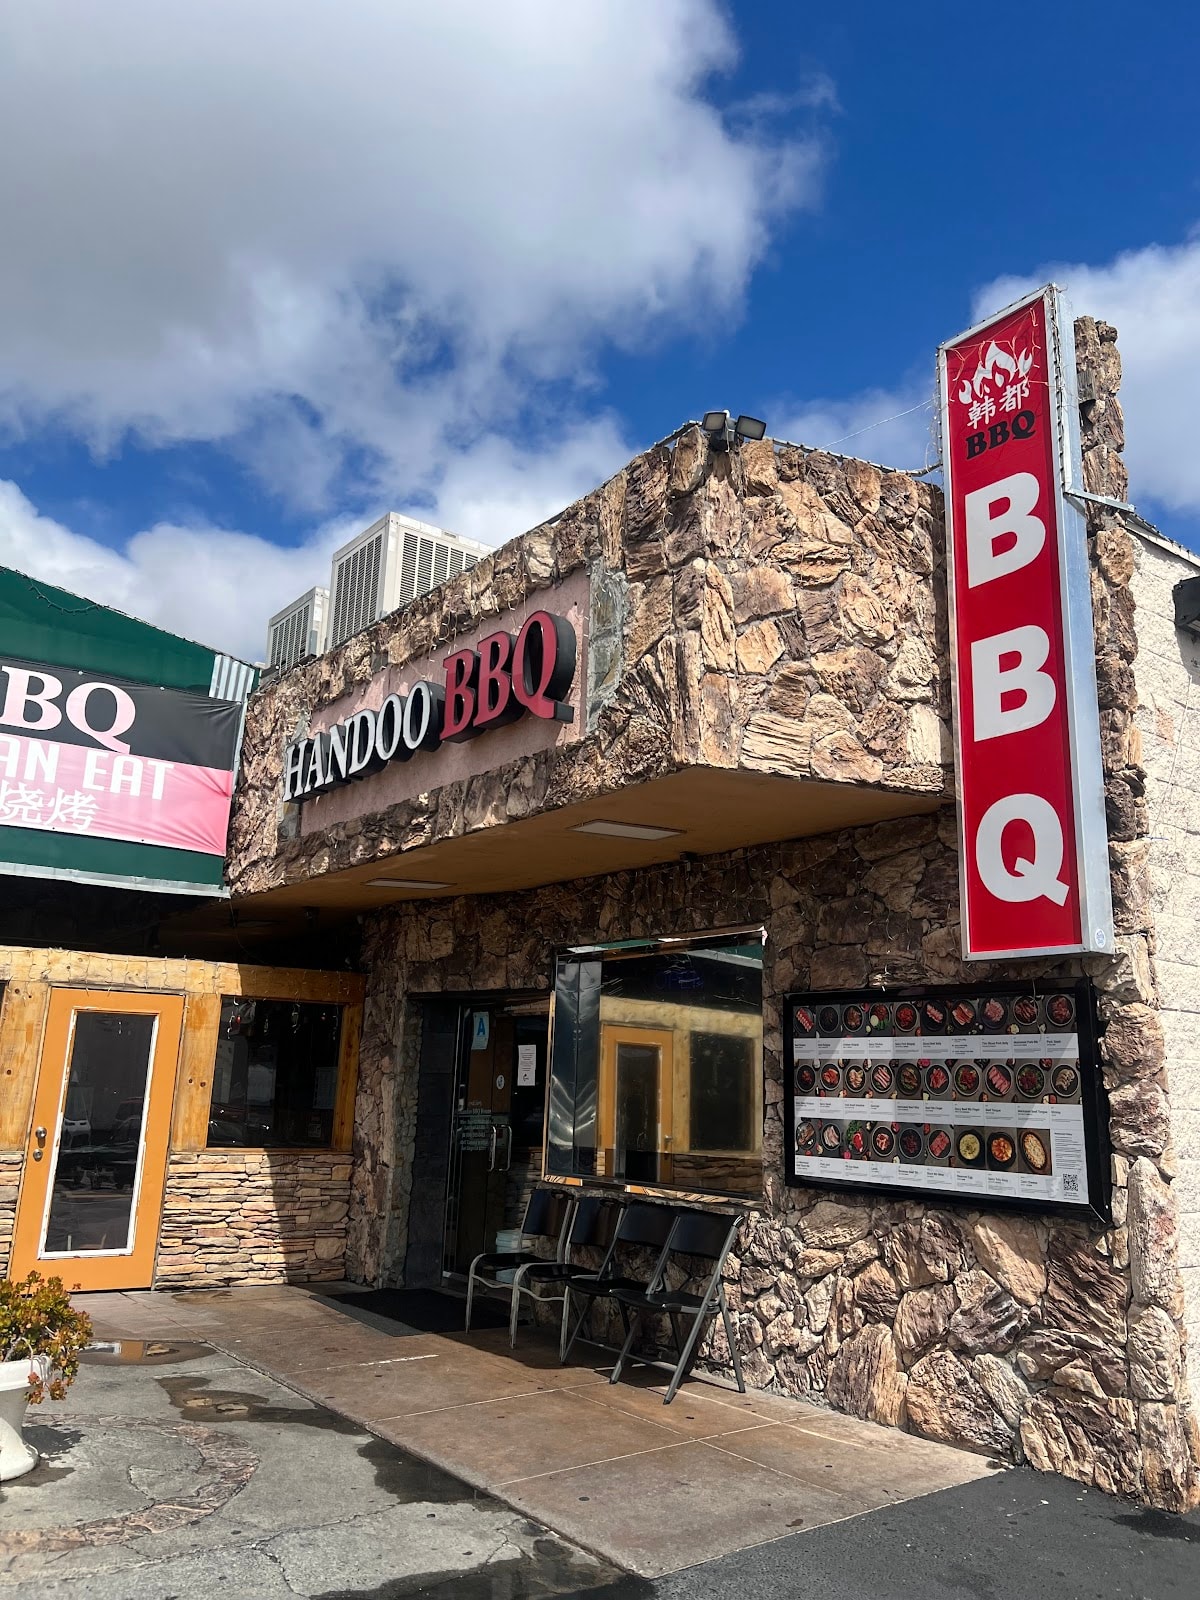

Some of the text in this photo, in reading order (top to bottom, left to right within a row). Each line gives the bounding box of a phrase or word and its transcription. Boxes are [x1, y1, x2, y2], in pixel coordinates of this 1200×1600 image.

[967, 380, 1030, 429] 韩都
[966, 410, 1036, 460] BBQ
[283, 610, 566, 802] HANDOO BBQ
[83, 749, 175, 800] EAT
[477, 1018, 486, 1036] A
